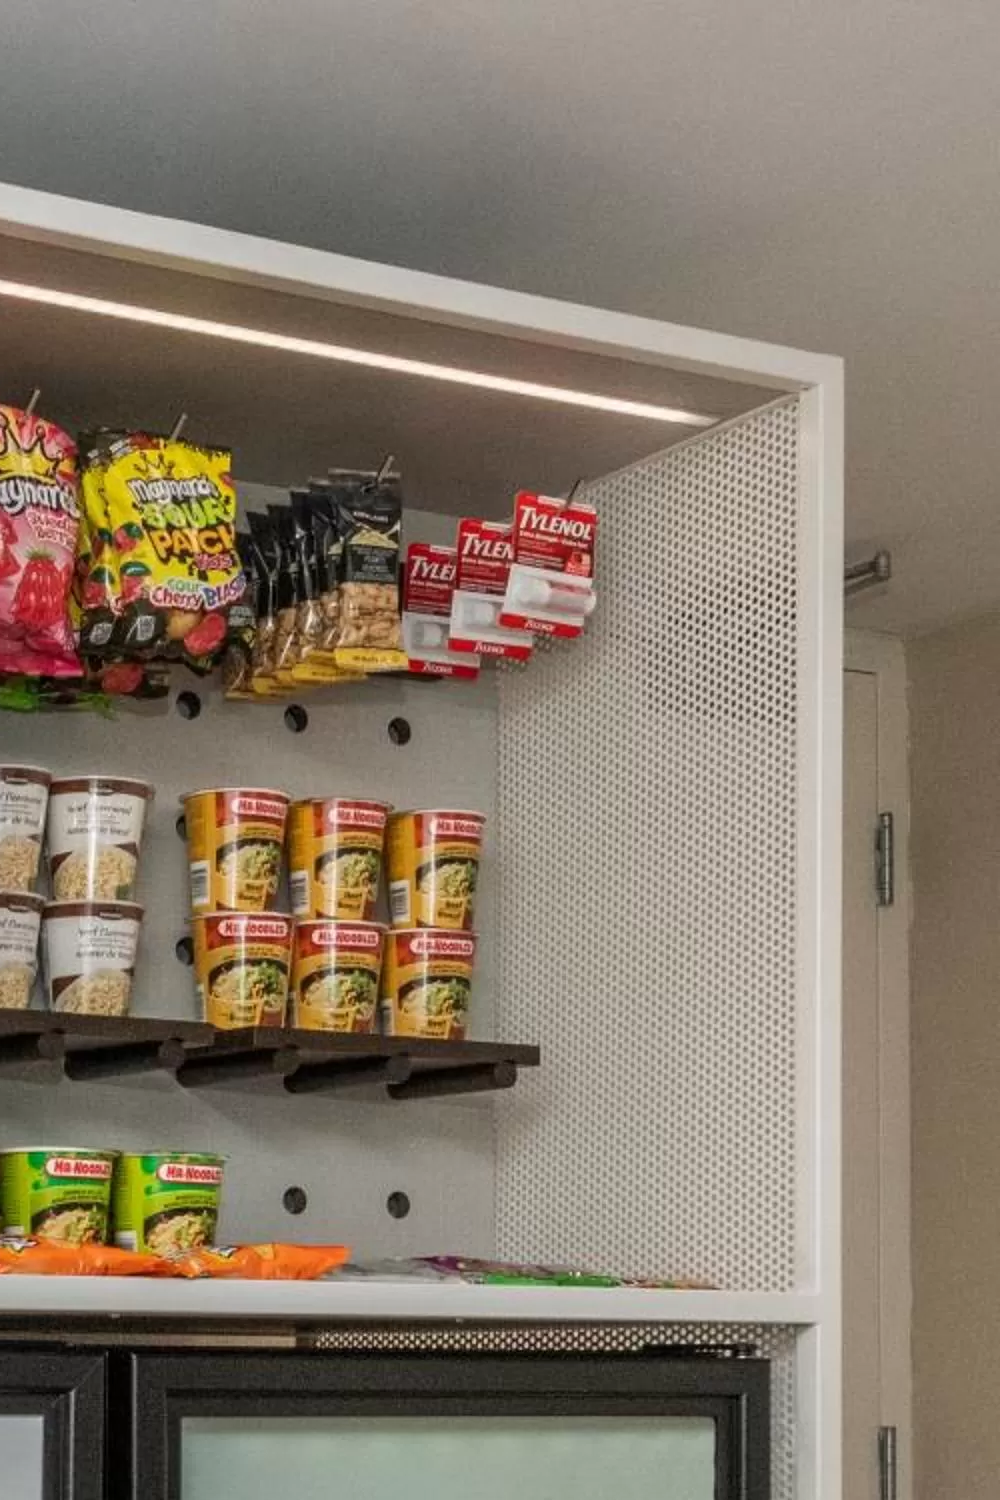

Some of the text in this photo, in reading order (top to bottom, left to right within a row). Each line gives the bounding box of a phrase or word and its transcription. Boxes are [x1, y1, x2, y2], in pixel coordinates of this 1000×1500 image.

[520, 506, 592, 540] TYLENOL
[462, 532, 514, 560] TYLEN
[411, 555, 456, 581] TYLE
